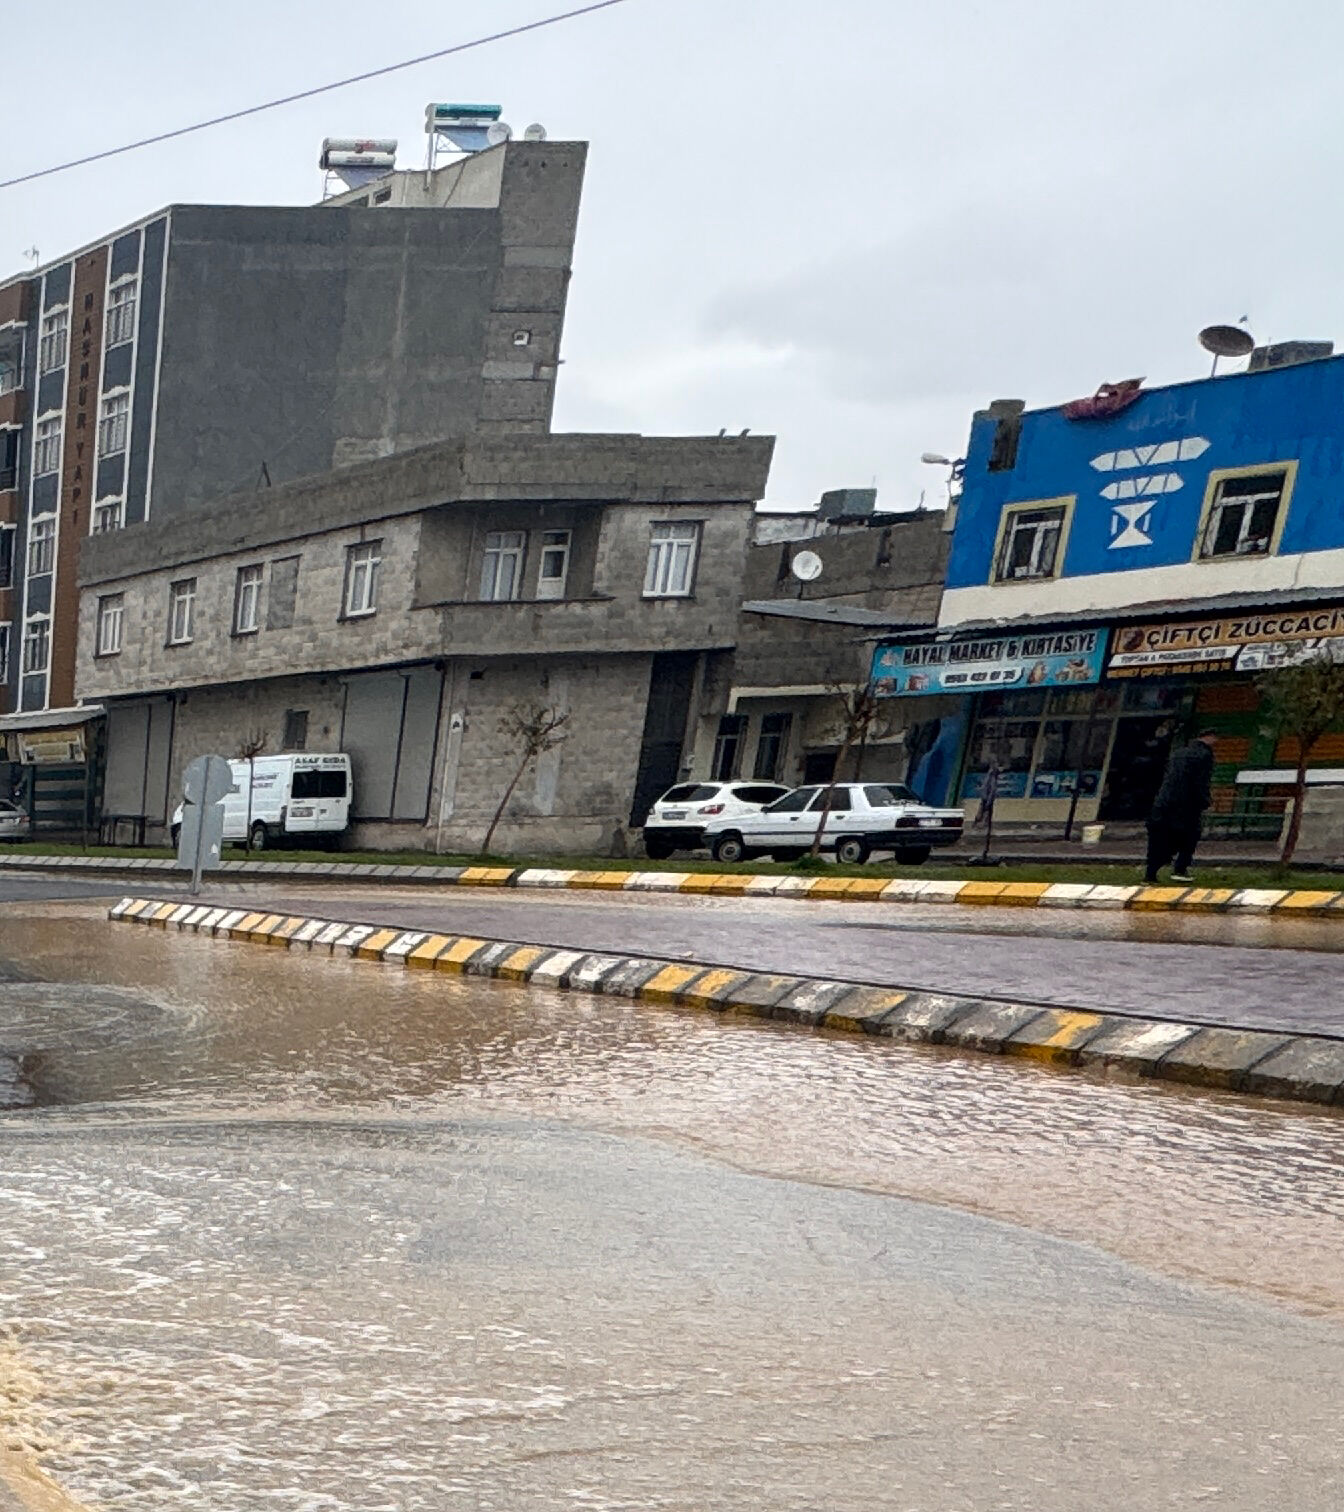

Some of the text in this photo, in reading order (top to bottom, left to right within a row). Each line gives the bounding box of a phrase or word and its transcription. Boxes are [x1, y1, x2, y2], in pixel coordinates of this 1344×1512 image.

[1228, 614, 1344, 639] ZÜCCACİ
[903, 644, 944, 665] HAYAL
[949, 640, 1004, 661] MARKET
